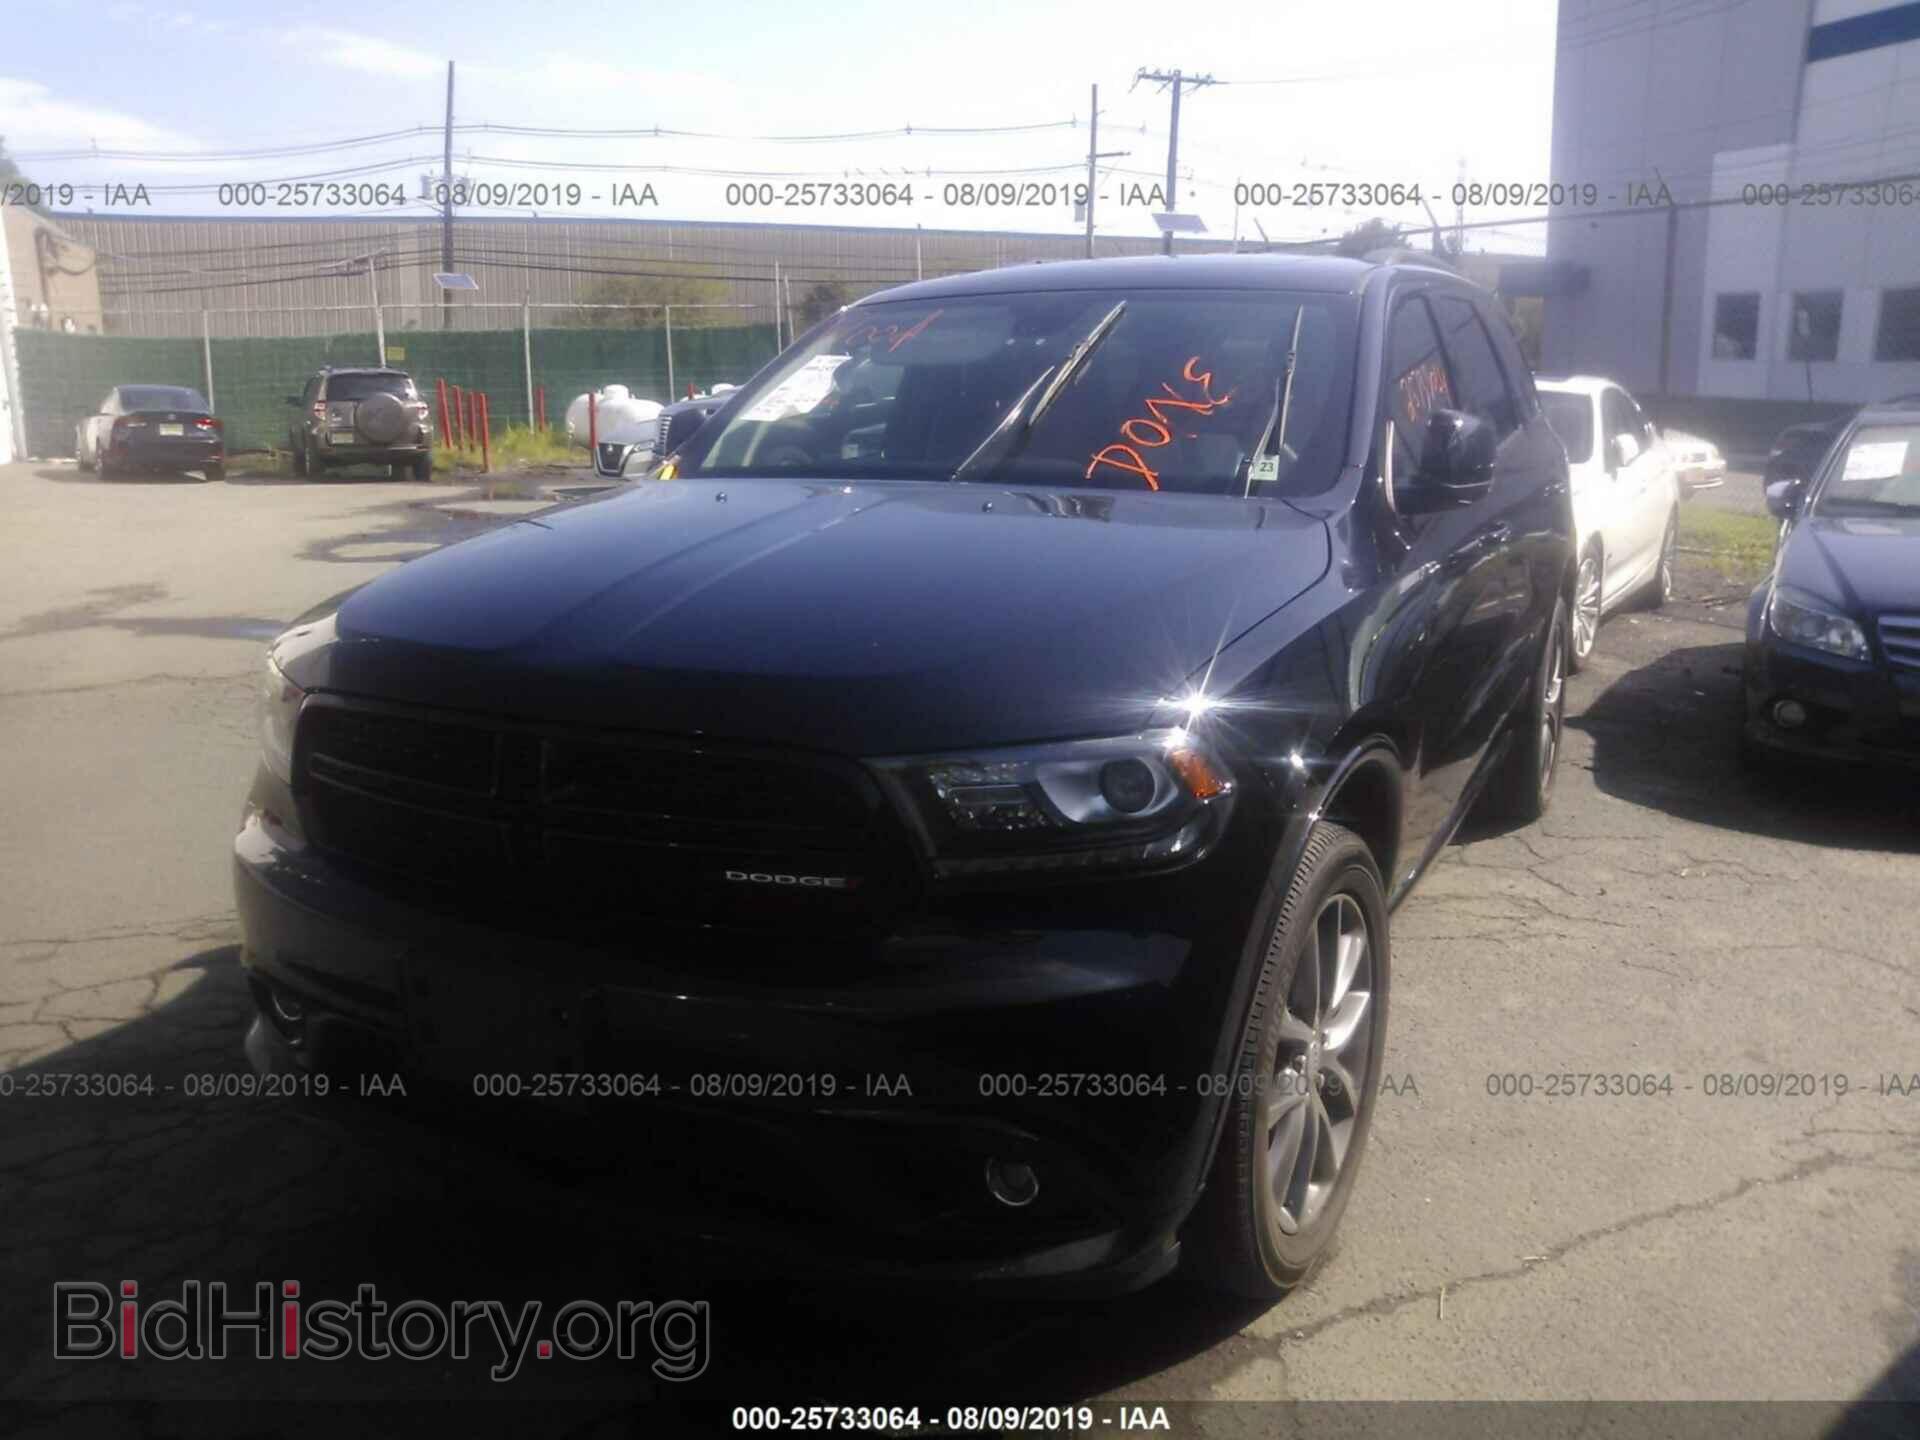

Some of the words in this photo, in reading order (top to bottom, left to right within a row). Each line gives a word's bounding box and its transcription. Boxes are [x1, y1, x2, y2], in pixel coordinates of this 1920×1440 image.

[1085, 355, 1236, 491] DONE
[1259, 462, 1274, 473] 23
[725, 870, 847, 888] DODGE
